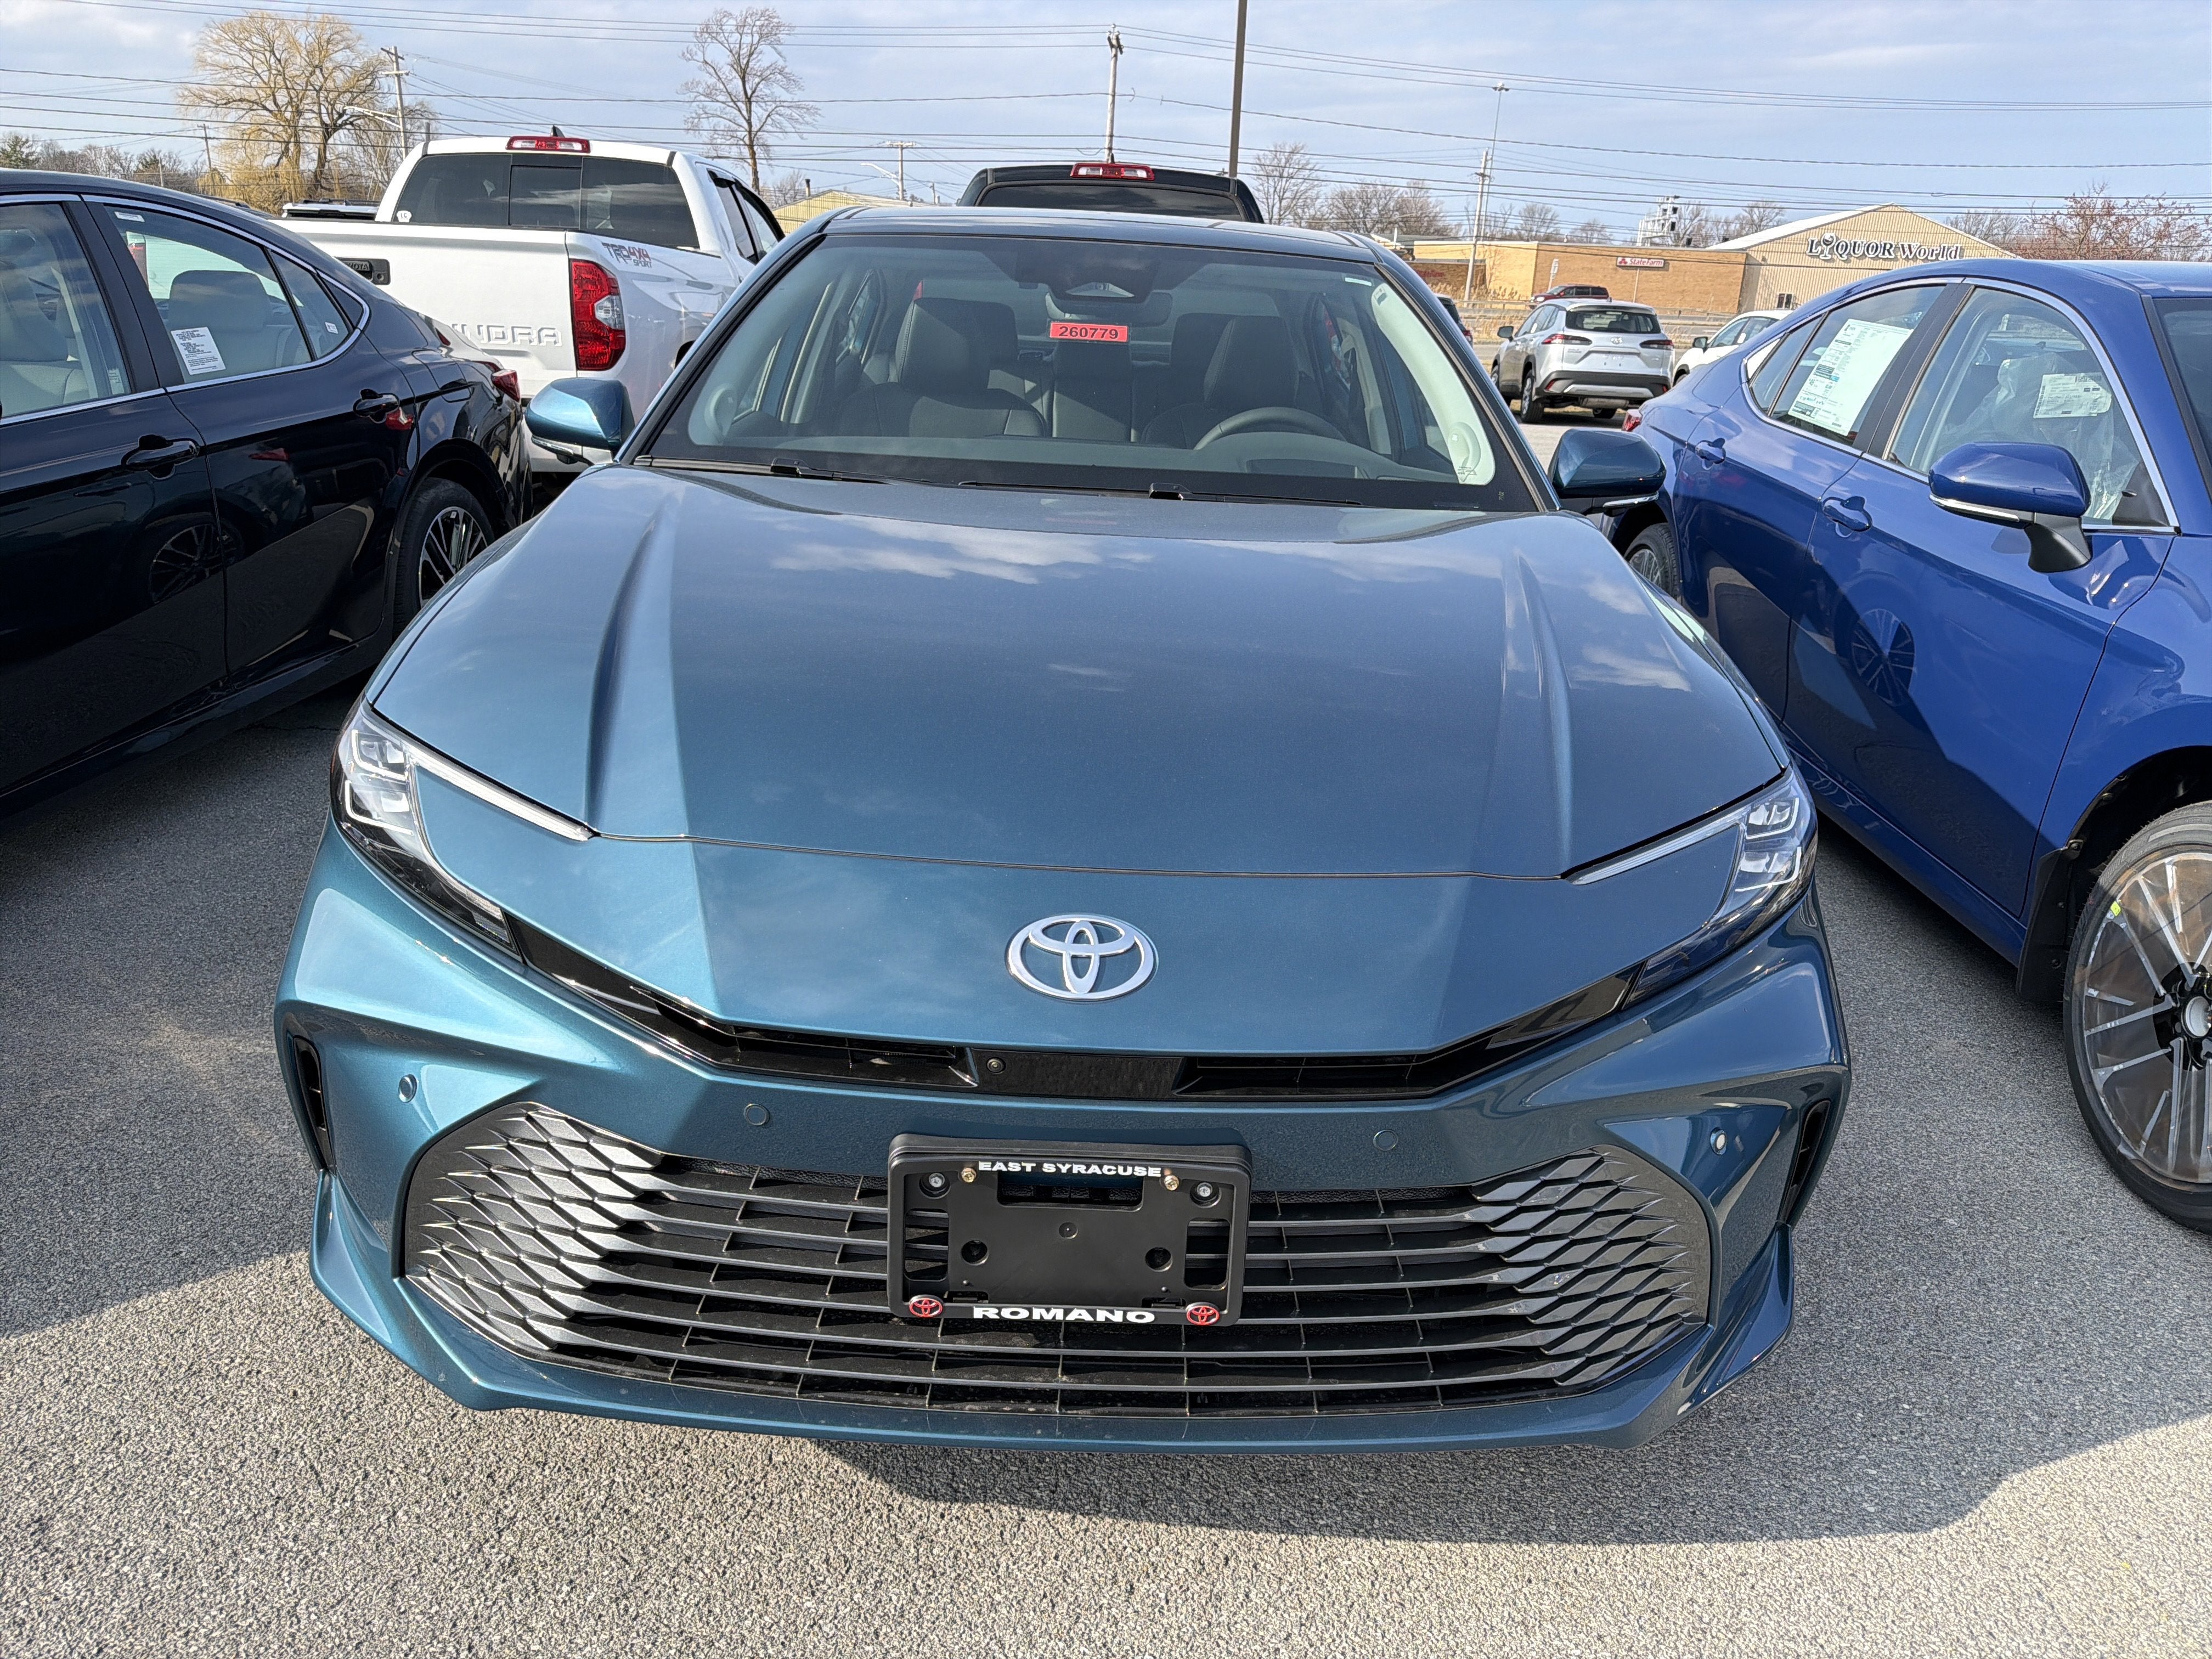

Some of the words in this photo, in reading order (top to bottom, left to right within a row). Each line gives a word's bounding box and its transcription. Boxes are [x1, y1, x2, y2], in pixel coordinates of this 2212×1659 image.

[1899, 242, 1961, 261] World
[633, 258, 652, 268] SPORT
[1058, 326, 1119, 340] 260779
[978, 1161, 1036, 1172] EAST
[1042, 1163, 1161, 1177] SYRACUSE
[973, 1306, 1155, 1323] ROMANO
